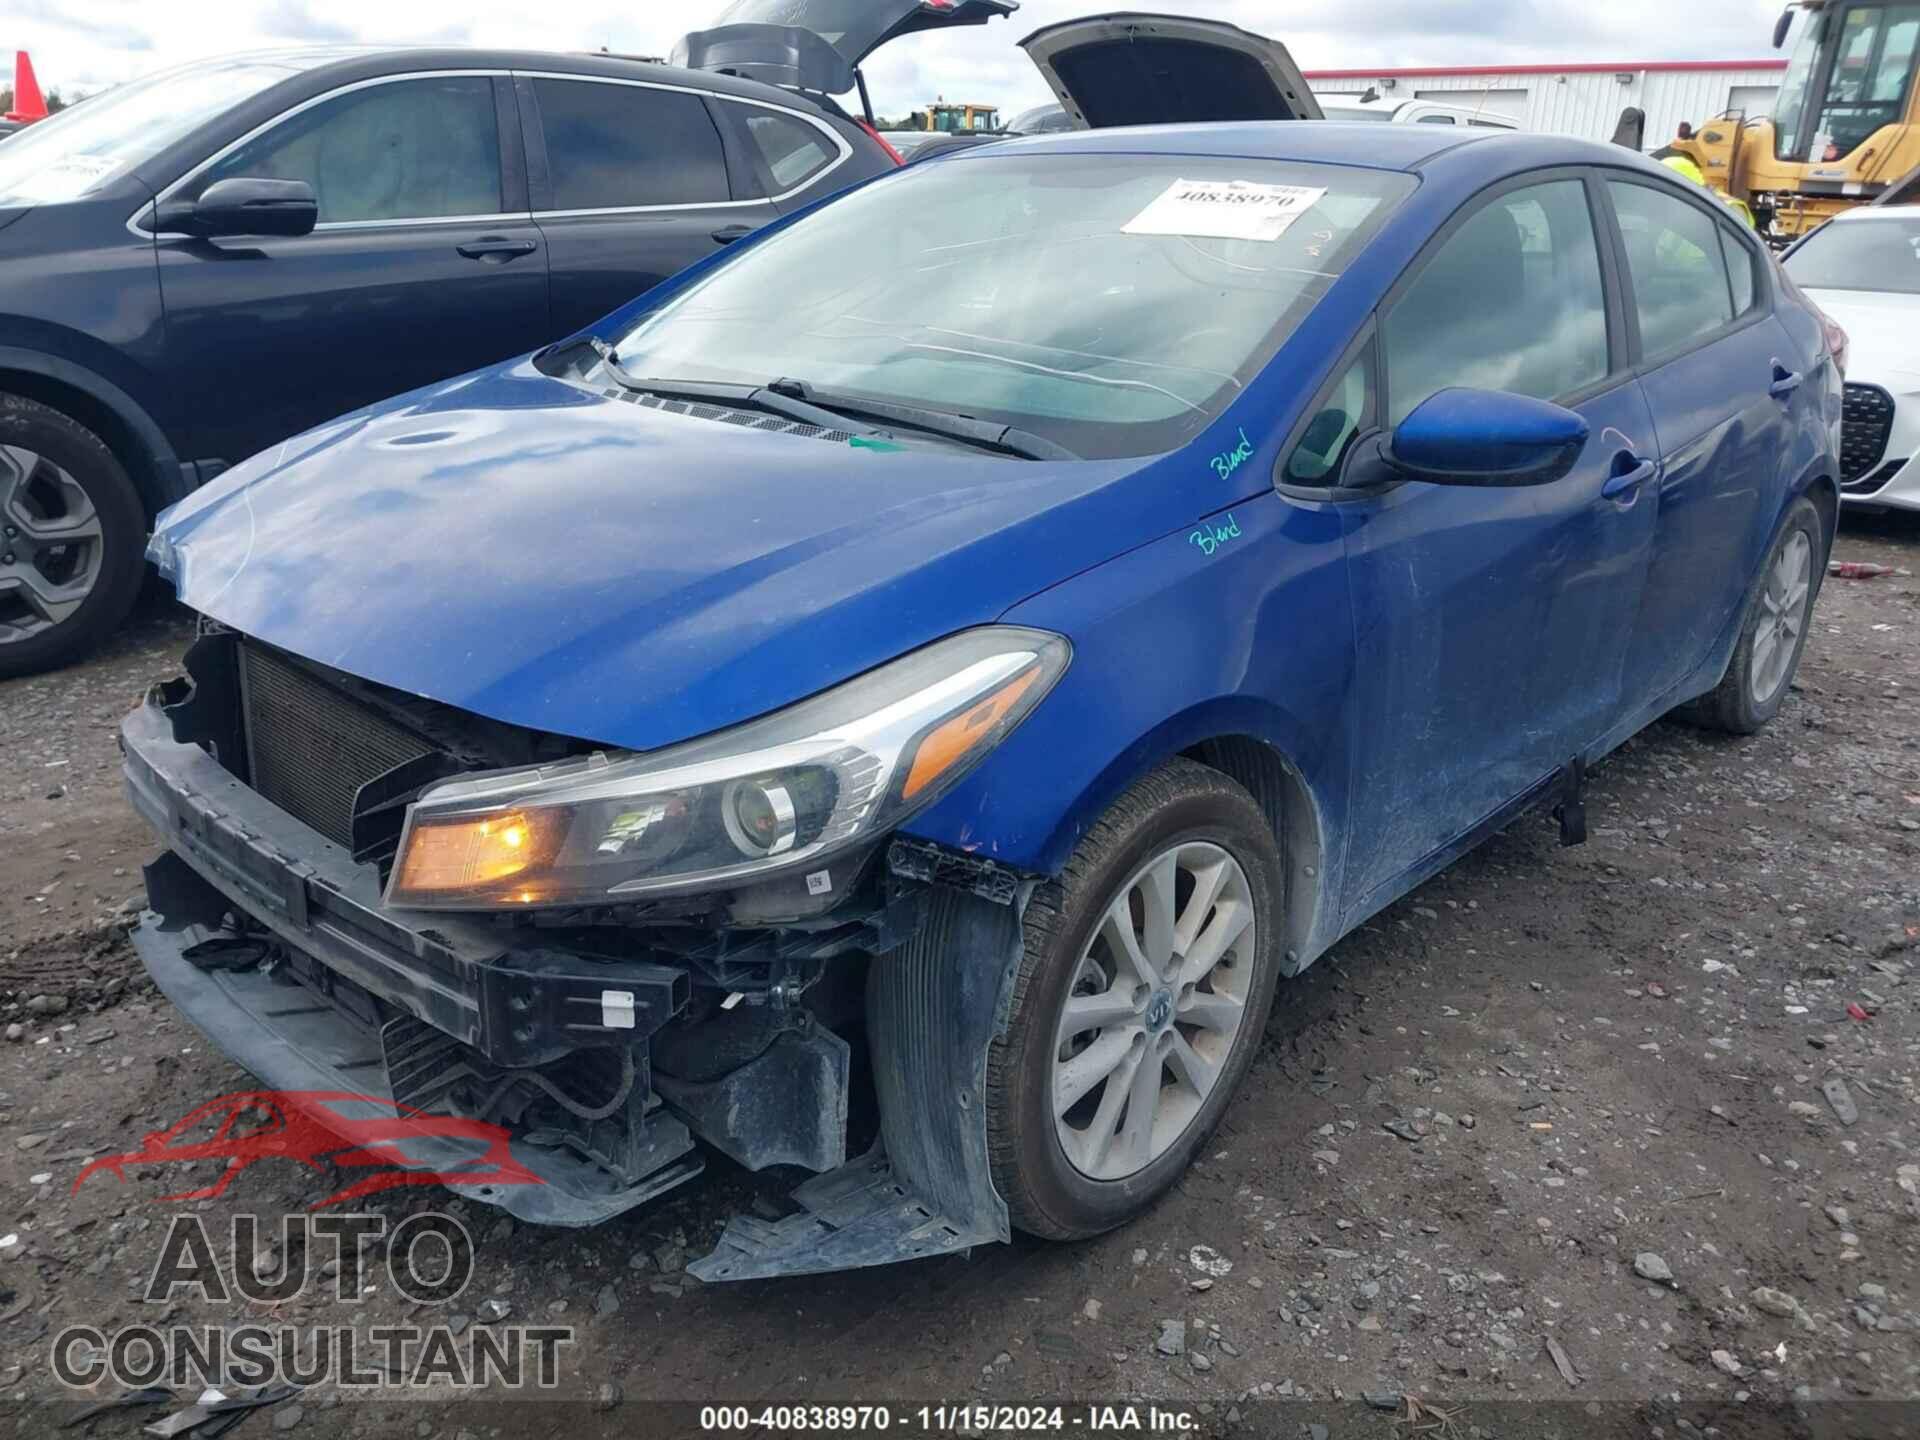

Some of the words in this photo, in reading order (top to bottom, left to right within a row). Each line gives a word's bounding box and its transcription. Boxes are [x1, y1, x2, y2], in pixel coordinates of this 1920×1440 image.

[1176, 191, 1295, 206] 40838970
[1210, 427, 1254, 480] Blend
[1189, 513, 1242, 555] Blend
